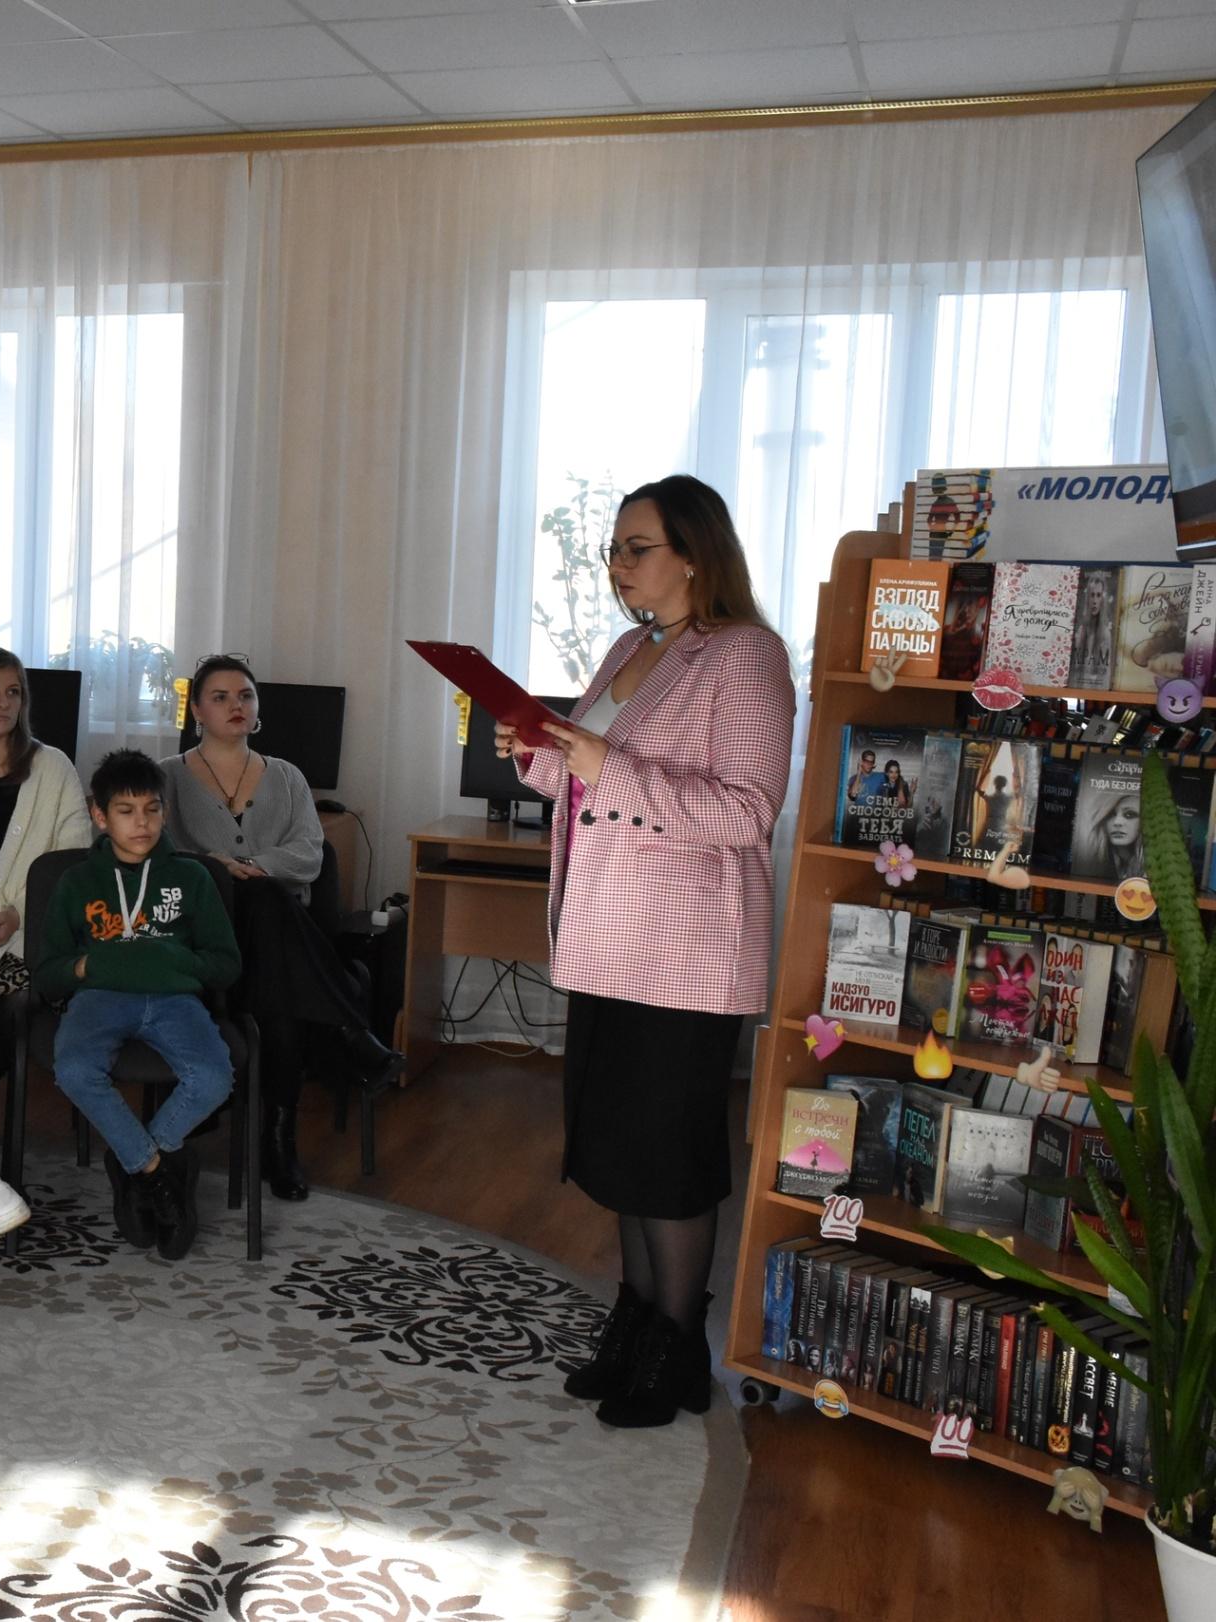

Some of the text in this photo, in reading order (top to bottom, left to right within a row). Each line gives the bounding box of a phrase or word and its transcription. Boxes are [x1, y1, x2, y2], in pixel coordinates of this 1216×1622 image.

[1017, 474, 1173, 505] «МОЛОД
[874, 586, 940, 612] ВЗГЛЯД
[1194, 570, 1207, 614] ДЖЕЙН
[871, 608, 940, 632] СКВОЗЬ
[869, 631, 937, 656] ПАЛЬЦЫ
[1089, 778, 1111, 790] ТУДА
[1111, 779, 1126, 790] БЕЗ
[848, 804, 915, 819] СПОСОБОВ
[865, 794, 901, 807] СЕМЬ
[857, 817, 905, 835] ТЕБЯ
[953, 846, 1033, 866] PREMUM
[831, 981, 870, 997] КАДЗУО
[829, 993, 897, 1017] ИСИГУРО
[804, 1123, 843, 1140] тобой
[903, 1107, 936, 1143] ПЕПЕЛ
[898, 1138, 934, 1169] ОКЕАНОМ
[1083, 1355, 1097, 1400] АССВЕТ
[1104, 1352, 1120, 1408] ЗМЕНИЕ
